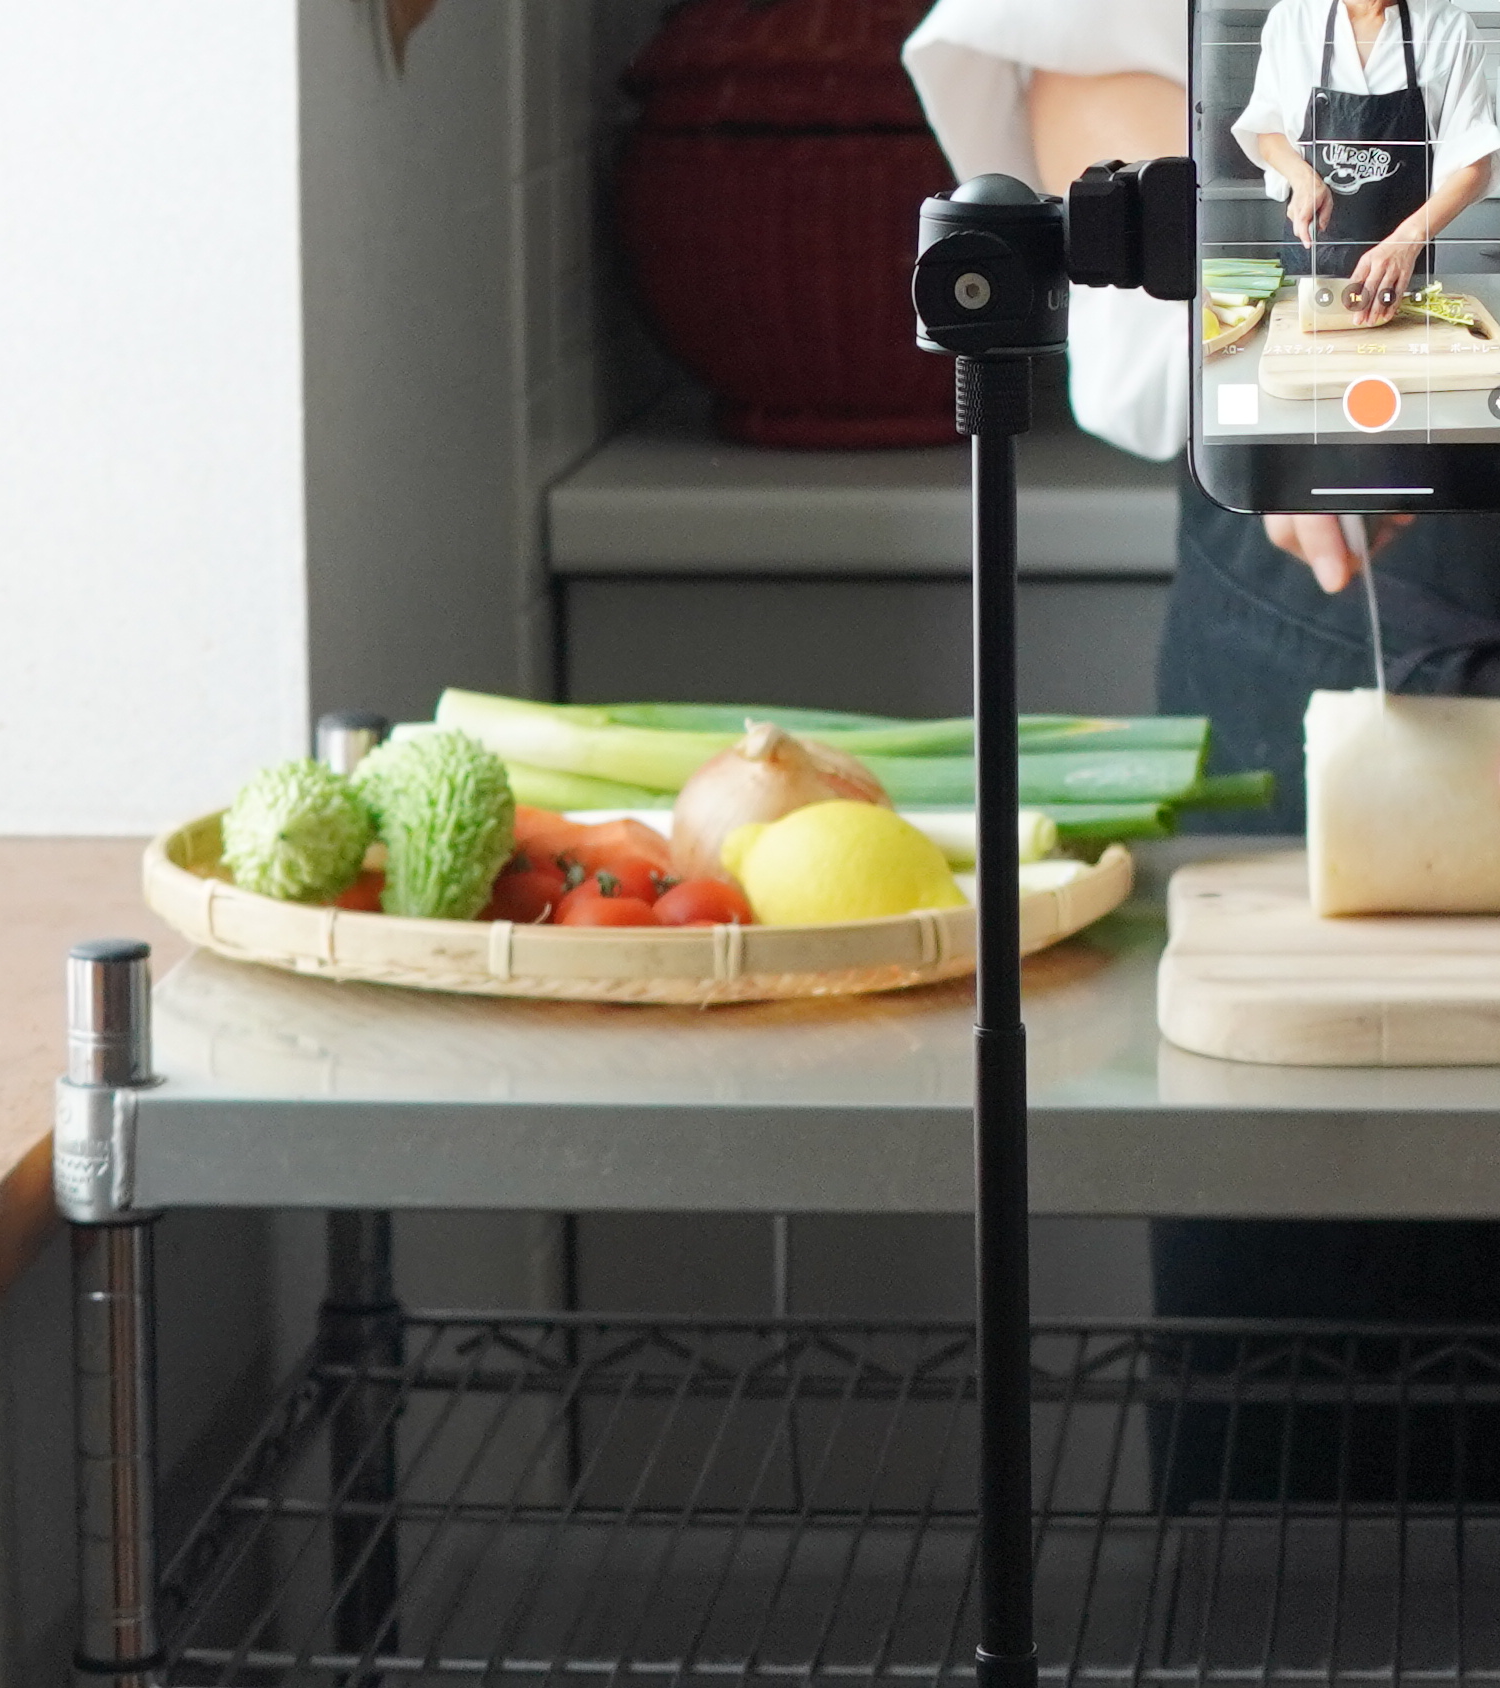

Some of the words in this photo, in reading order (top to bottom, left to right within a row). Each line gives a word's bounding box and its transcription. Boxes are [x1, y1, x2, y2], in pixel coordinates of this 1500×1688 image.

[1383, 292, 1392, 303] 2
[1356, 343, 1388, 355] ビデオ
[1408, 343, 1430, 355] 写真
